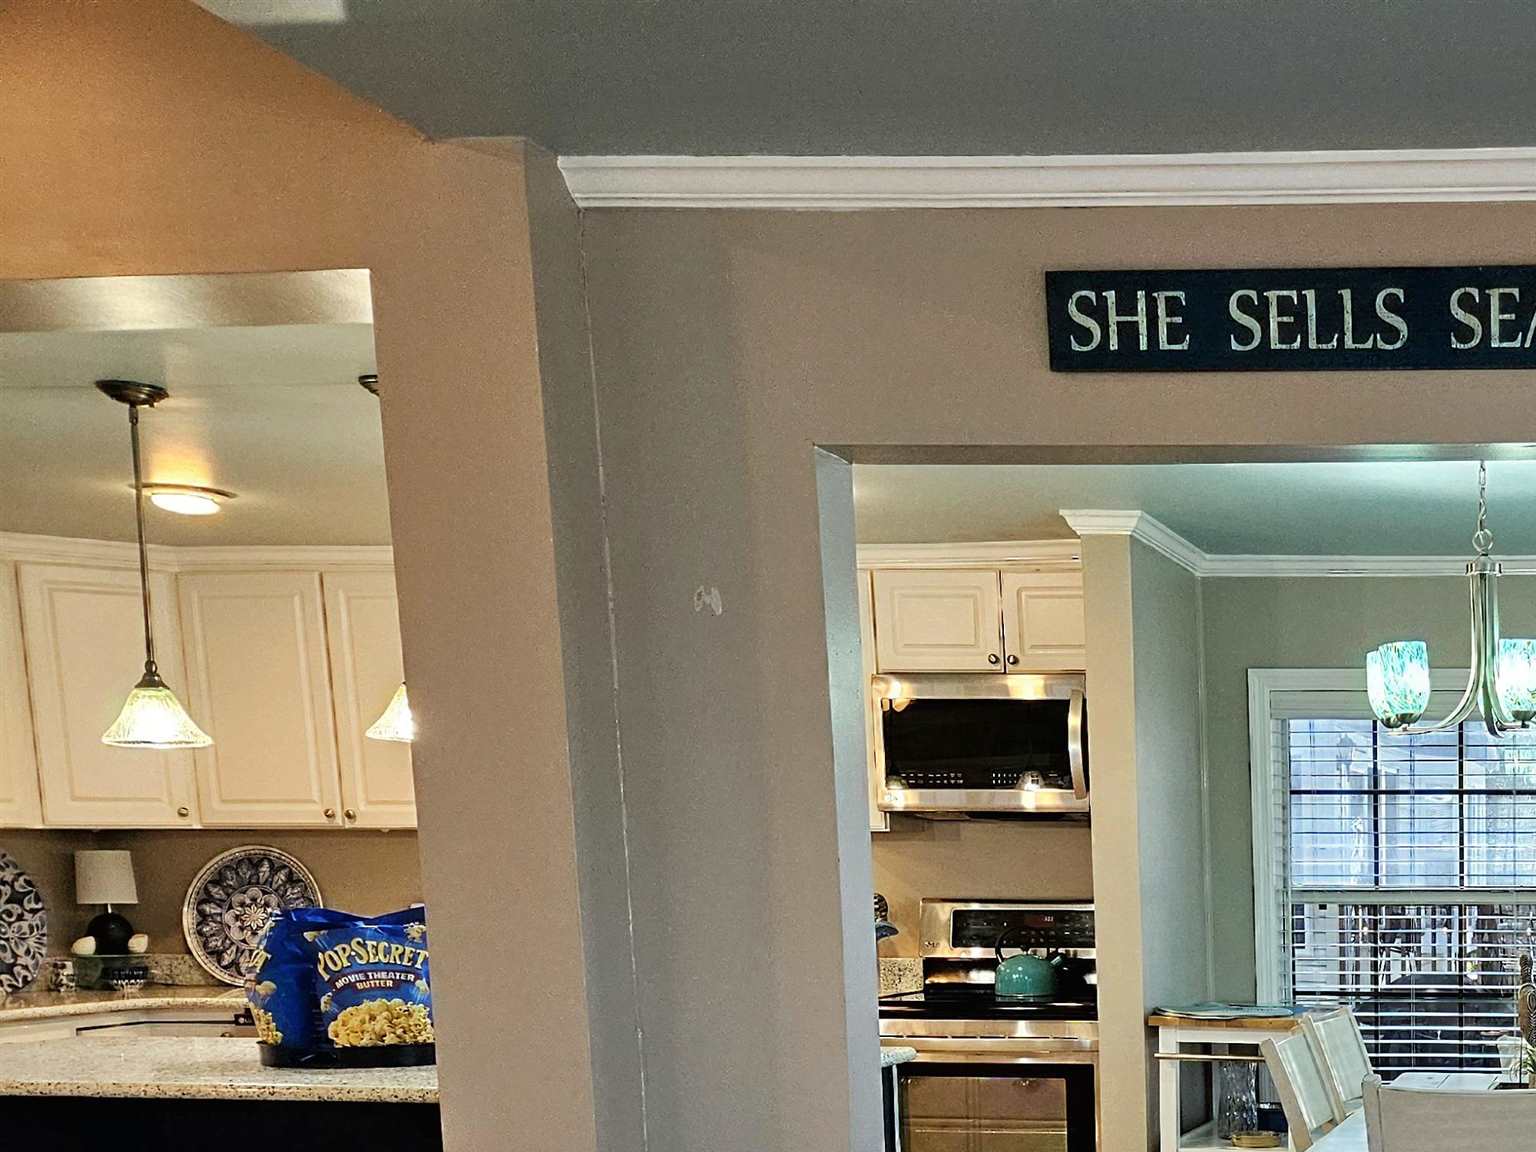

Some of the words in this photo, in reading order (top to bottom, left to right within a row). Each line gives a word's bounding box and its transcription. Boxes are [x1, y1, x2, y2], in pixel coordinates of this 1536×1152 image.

[1068, 289, 1190, 352] SHE
[1228, 287, 1408, 351] SELLS
[335, 972, 366, 989] MOVIE
[367, 971, 415, 982] THEATER
[356, 980, 394, 990] BUTTER
